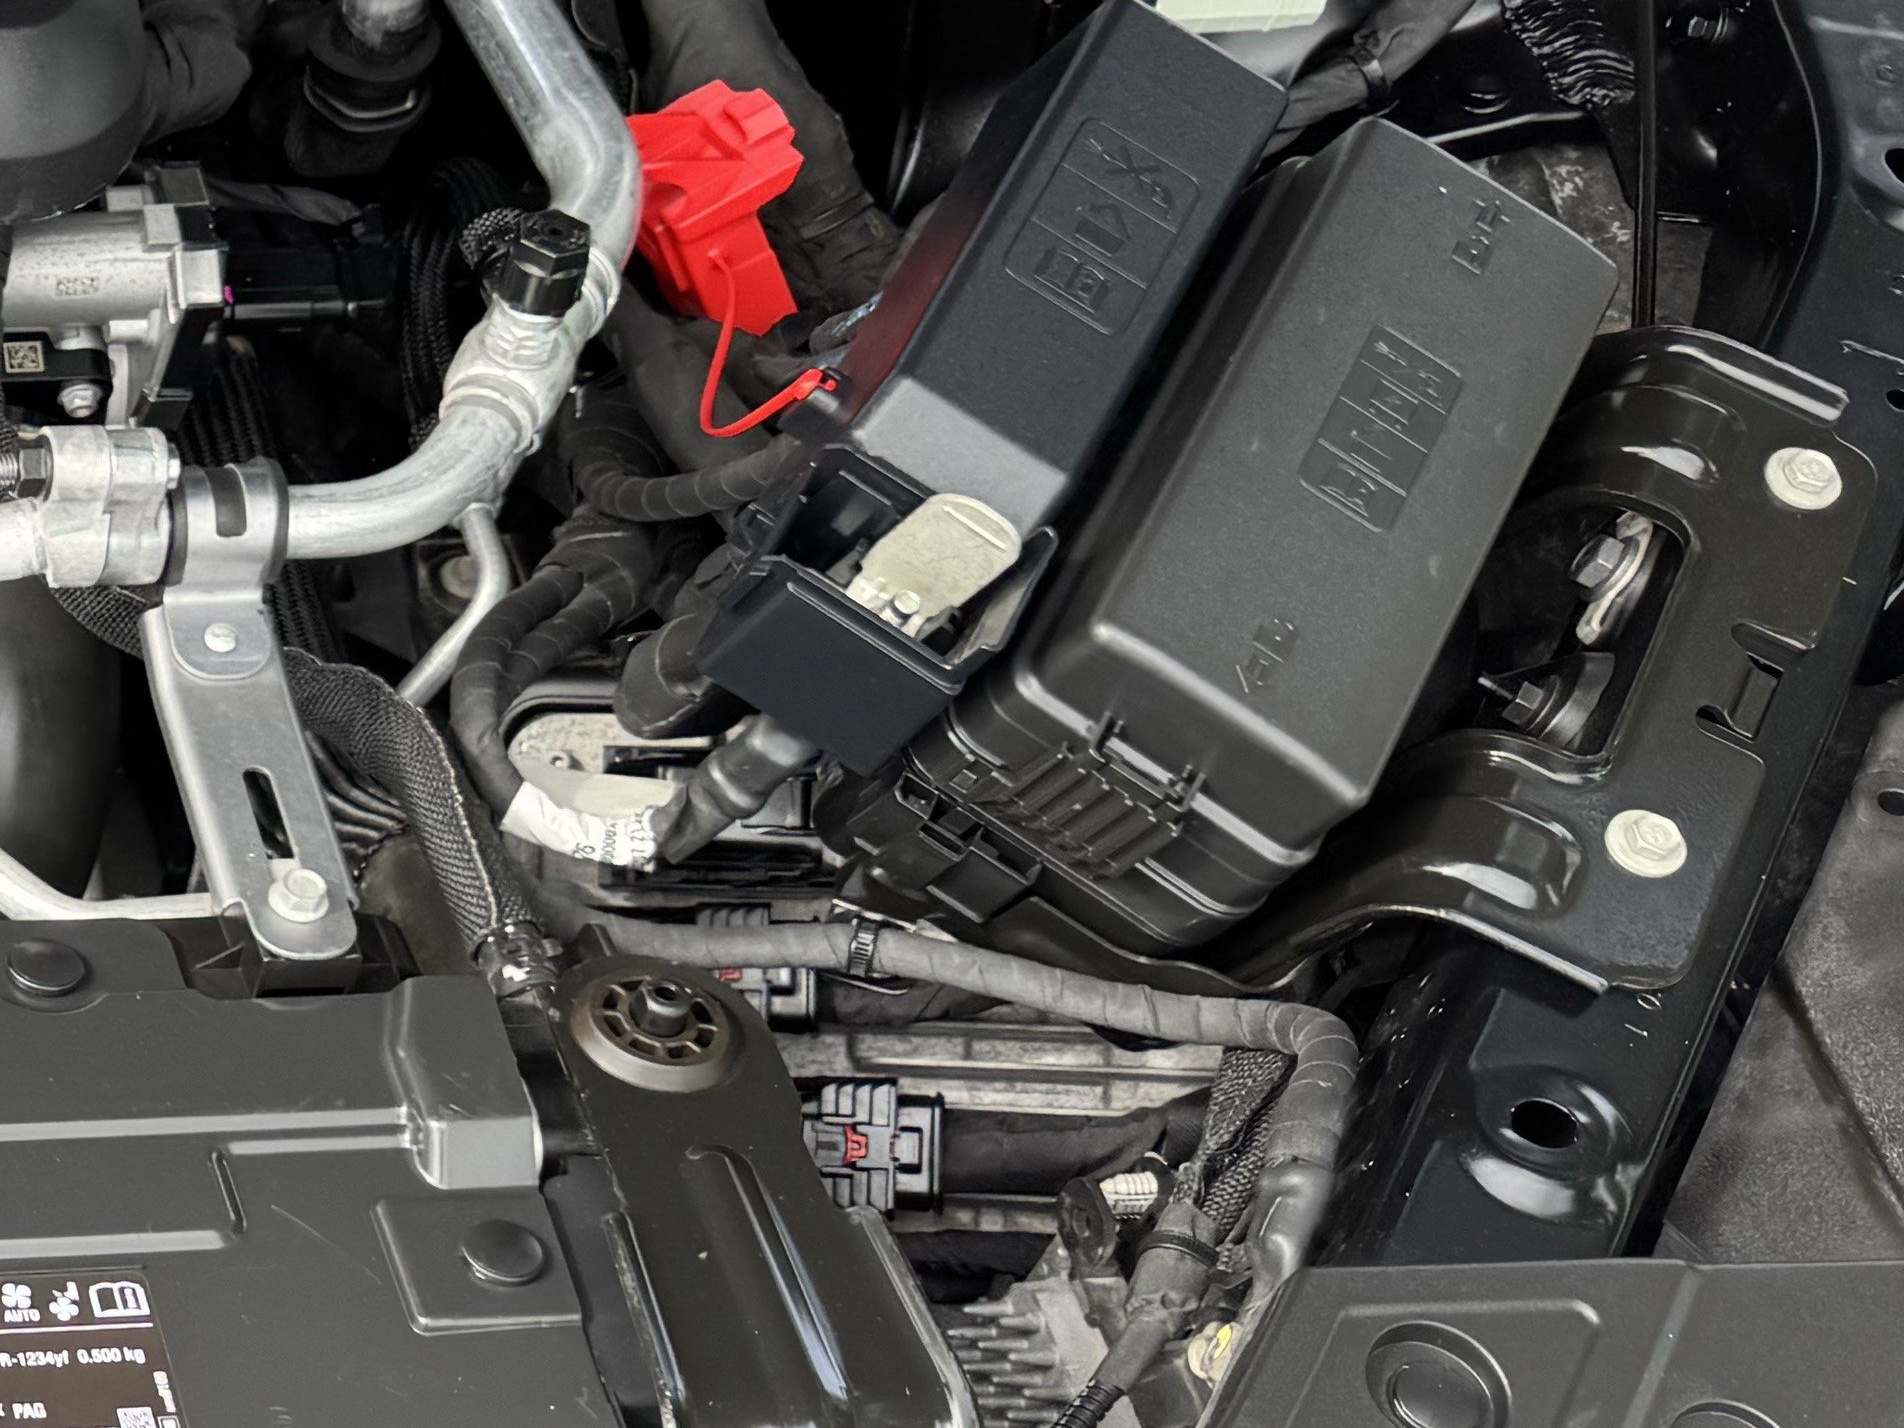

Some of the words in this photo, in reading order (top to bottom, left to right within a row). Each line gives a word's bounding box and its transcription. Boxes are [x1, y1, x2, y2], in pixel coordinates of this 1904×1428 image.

[3, 1308, 41, 1323] AUTO
[76, 1347, 123, 1365] 0.500
[125, 1347, 146, 1366] kg
